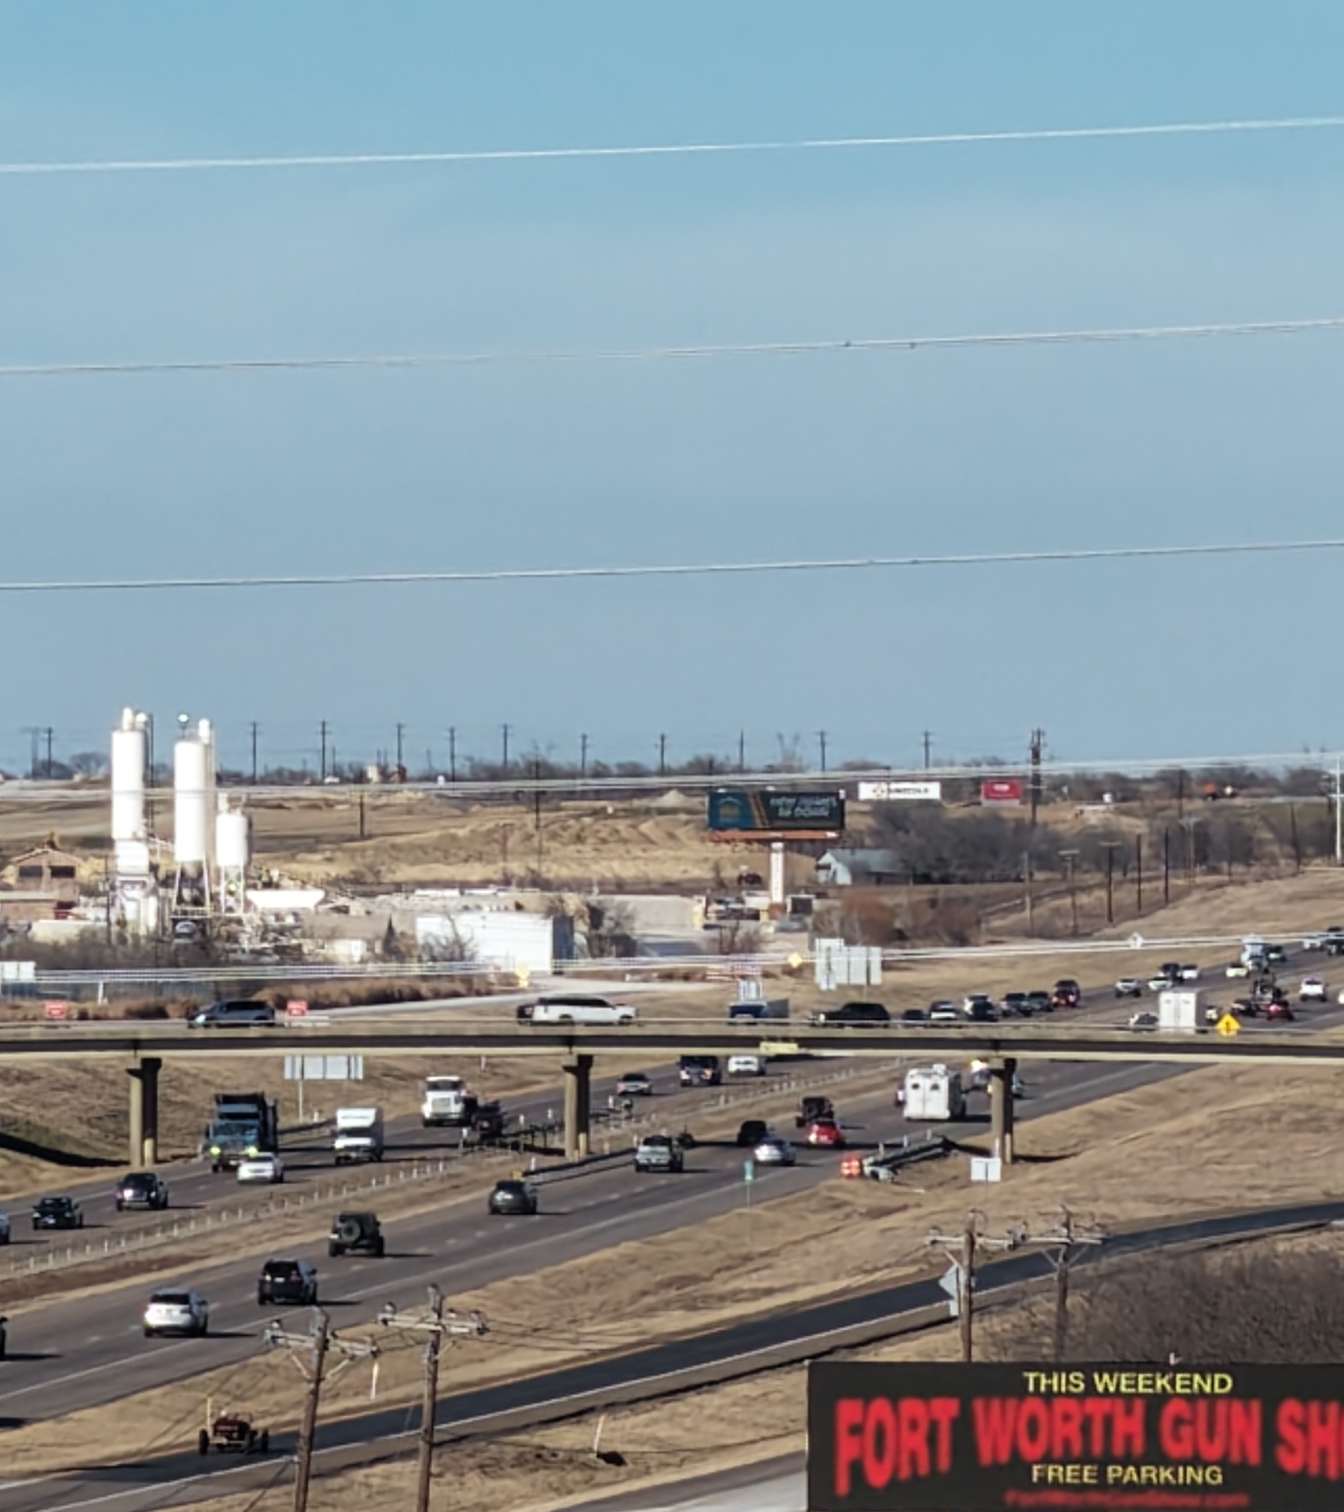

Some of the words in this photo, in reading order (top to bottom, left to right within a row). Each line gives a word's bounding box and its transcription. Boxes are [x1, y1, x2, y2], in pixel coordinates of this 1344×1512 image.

[1023, 1371, 1086, 1394] THIS
[1093, 1372, 1233, 1395] WEEKEND
[835, 1397, 960, 1496] FORT
[972, 1397, 1147, 1465] WORTH
[1159, 1398, 1262, 1467] GUN
[1031, 1464, 1098, 1485] FREE
[1107, 1465, 1223, 1486] PARKING
